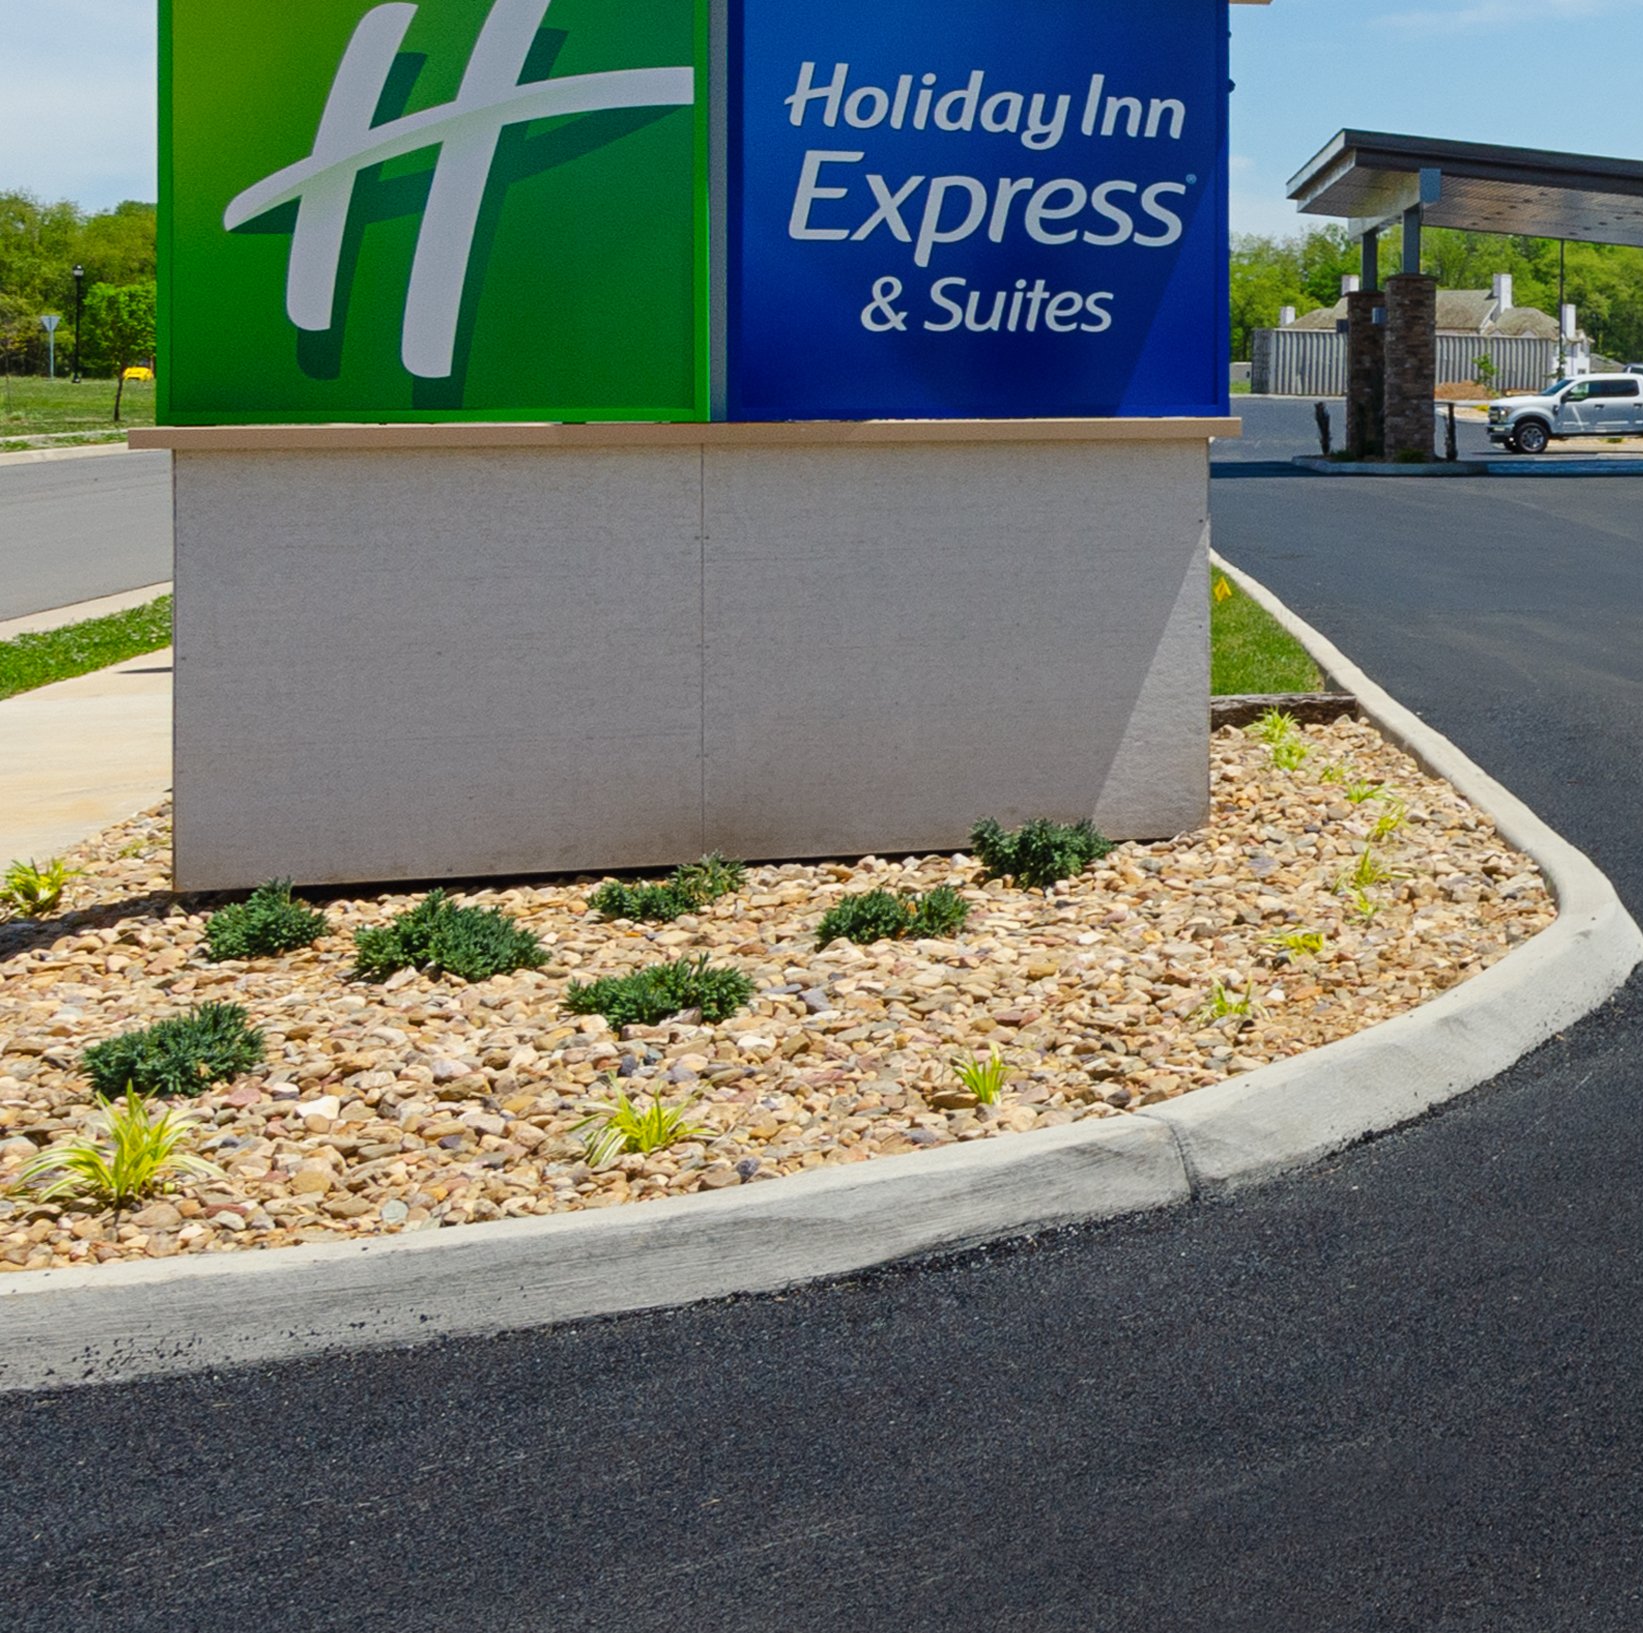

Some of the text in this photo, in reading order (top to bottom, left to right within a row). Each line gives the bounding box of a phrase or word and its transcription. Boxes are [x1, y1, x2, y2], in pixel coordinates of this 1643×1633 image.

[784, 60, 1186, 151] Holiday Inn
[787, 149, 1187, 268] Express
[860, 275, 1115, 333] & Suites
